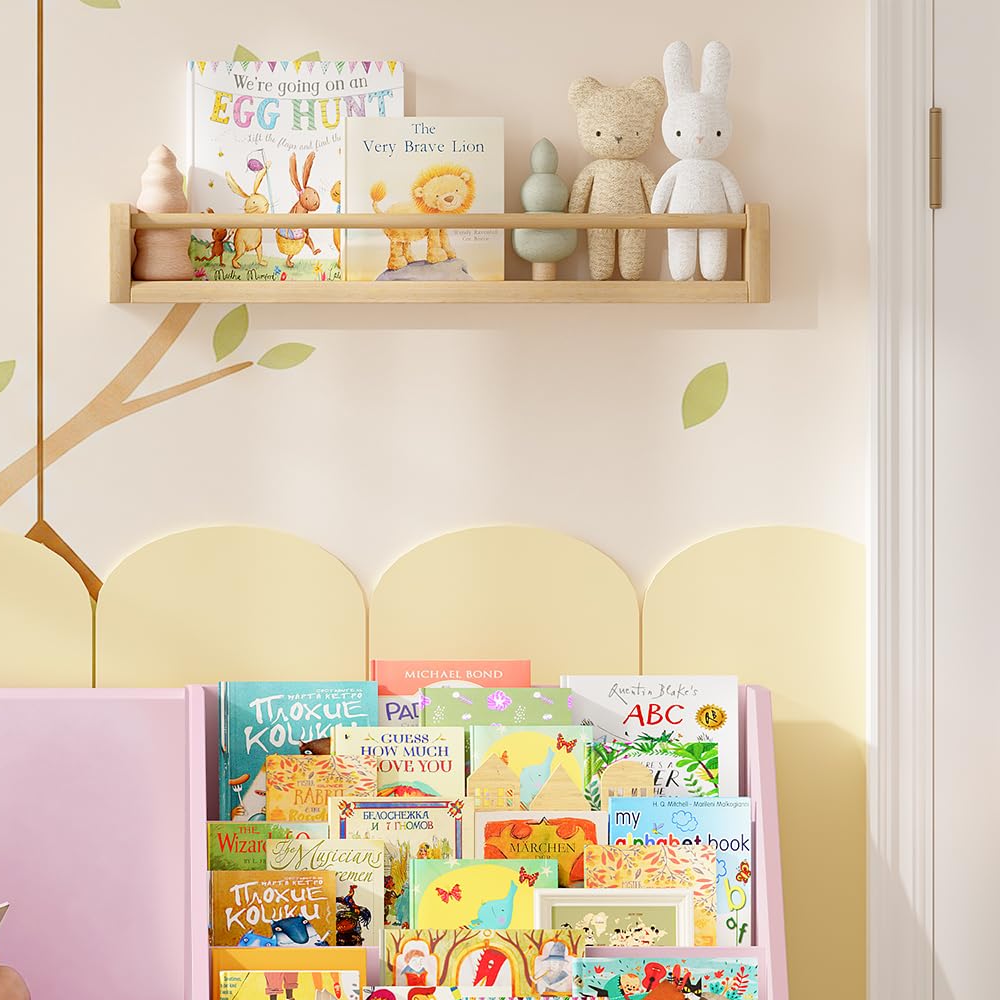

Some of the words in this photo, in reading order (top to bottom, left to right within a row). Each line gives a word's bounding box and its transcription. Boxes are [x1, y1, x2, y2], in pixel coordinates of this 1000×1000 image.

[234, 74, 272, 90] We're
[278, 80, 320, 96] going
[326, 79, 345, 91] on
[349, 77, 368, 88] an
[210, 91, 280, 130] EGG
[291, 89, 394, 130] HUNT
[412, 123, 436, 134] The
[363, 140, 396, 157] Very
[404, 140, 445, 153] Brave
[452, 140, 485, 153] Lion
[404, 670, 461, 679] MICHAEL
[466, 670, 503, 679] BOND
[623, 703, 685, 726] ABC
[381, 734, 429, 743] GUESS
[361, 746, 397, 757] HOW
[403, 746, 449, 757] MUCH
[377, 760, 414, 773] OVE
[418, 760, 453, 773] YOU
[363, 811, 429, 820] БЕЛОСНЕЖКА
[615, 811, 641, 829] my
[239, 826, 260, 834] THE
[394, 821, 434, 830] ГНОМОВ
[510, 841, 576, 853] MÄRCHEN
[708, 833, 750, 852] book
[334, 871, 374, 883] remen
